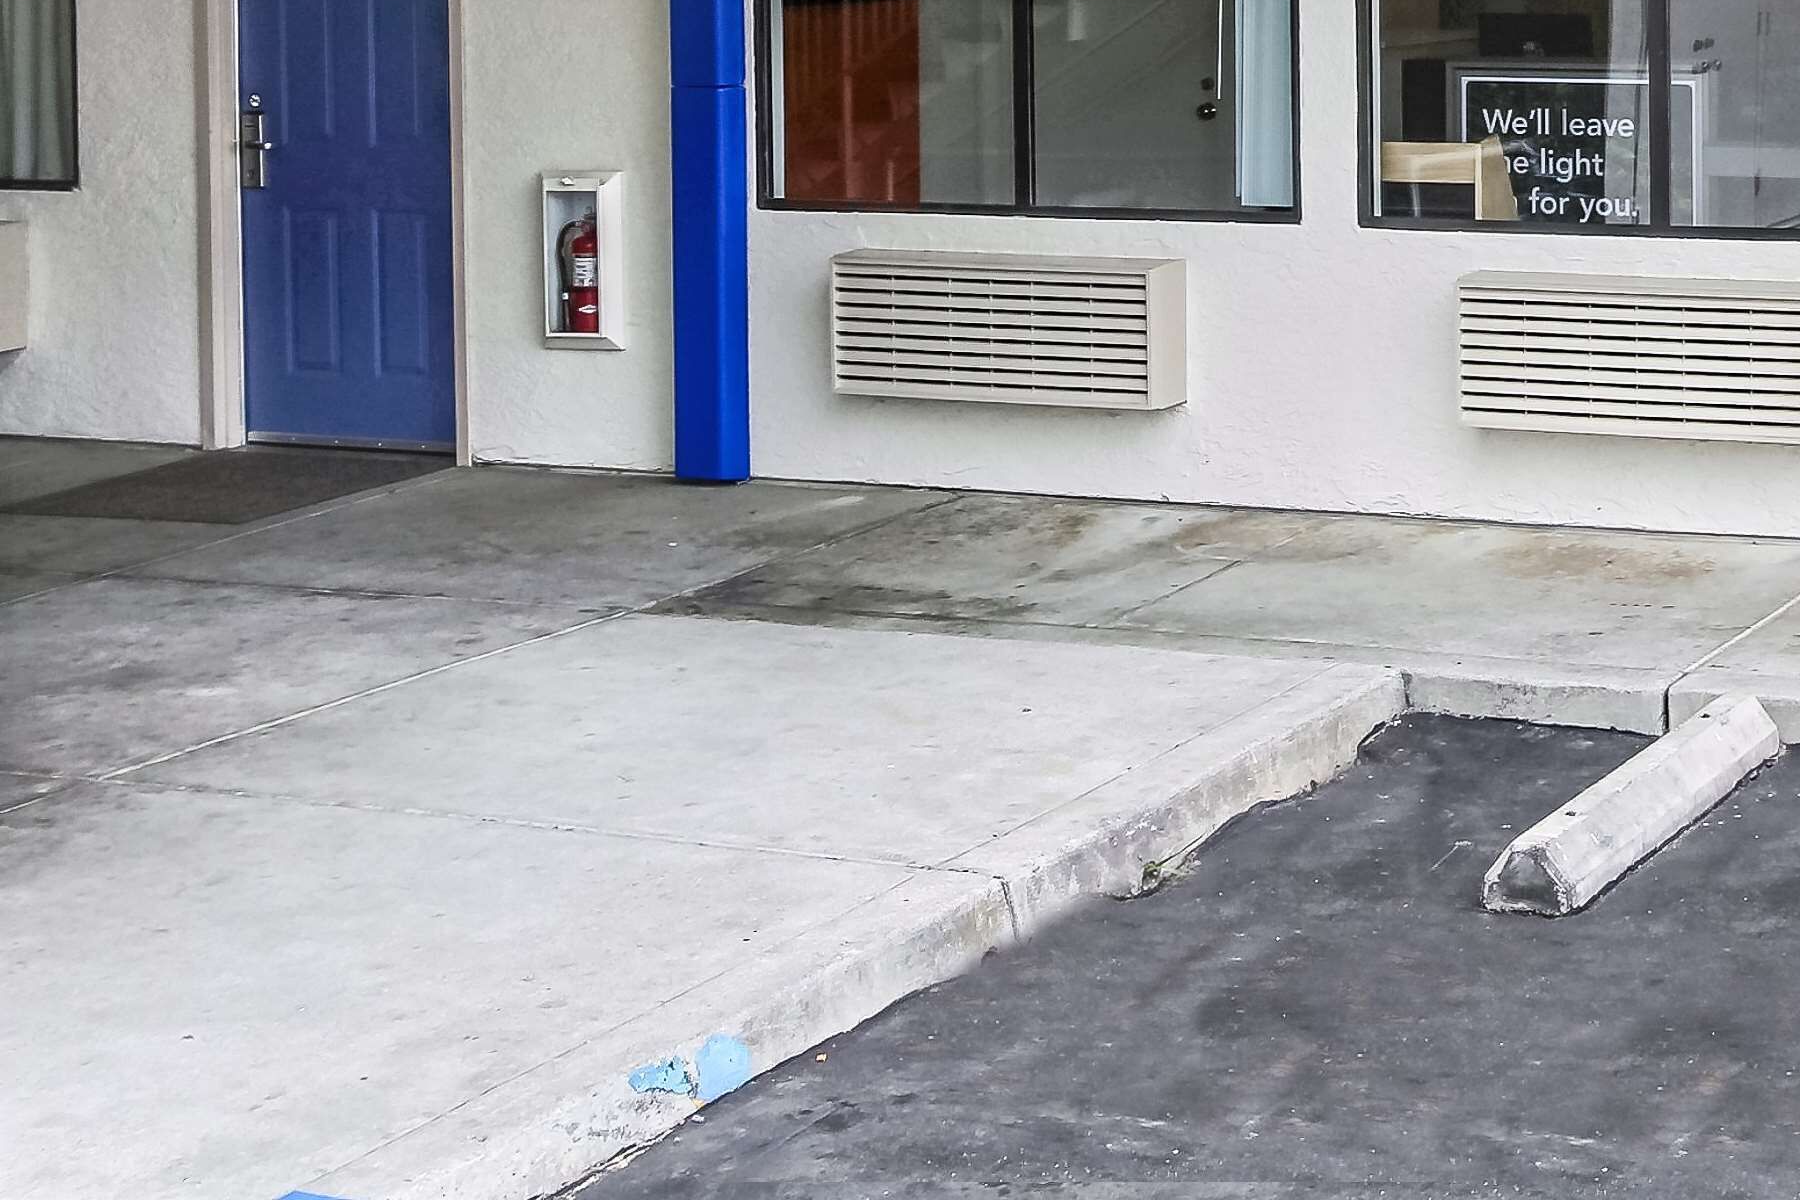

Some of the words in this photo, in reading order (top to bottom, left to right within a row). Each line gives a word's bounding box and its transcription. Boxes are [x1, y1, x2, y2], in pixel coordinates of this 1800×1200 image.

[1482, 107, 1550, 135] We'll
[1561, 108, 1635, 138] leave
[1540, 147, 1604, 183] light
[1528, 186, 1570, 215] for
[1579, 197, 1639, 224] you.
